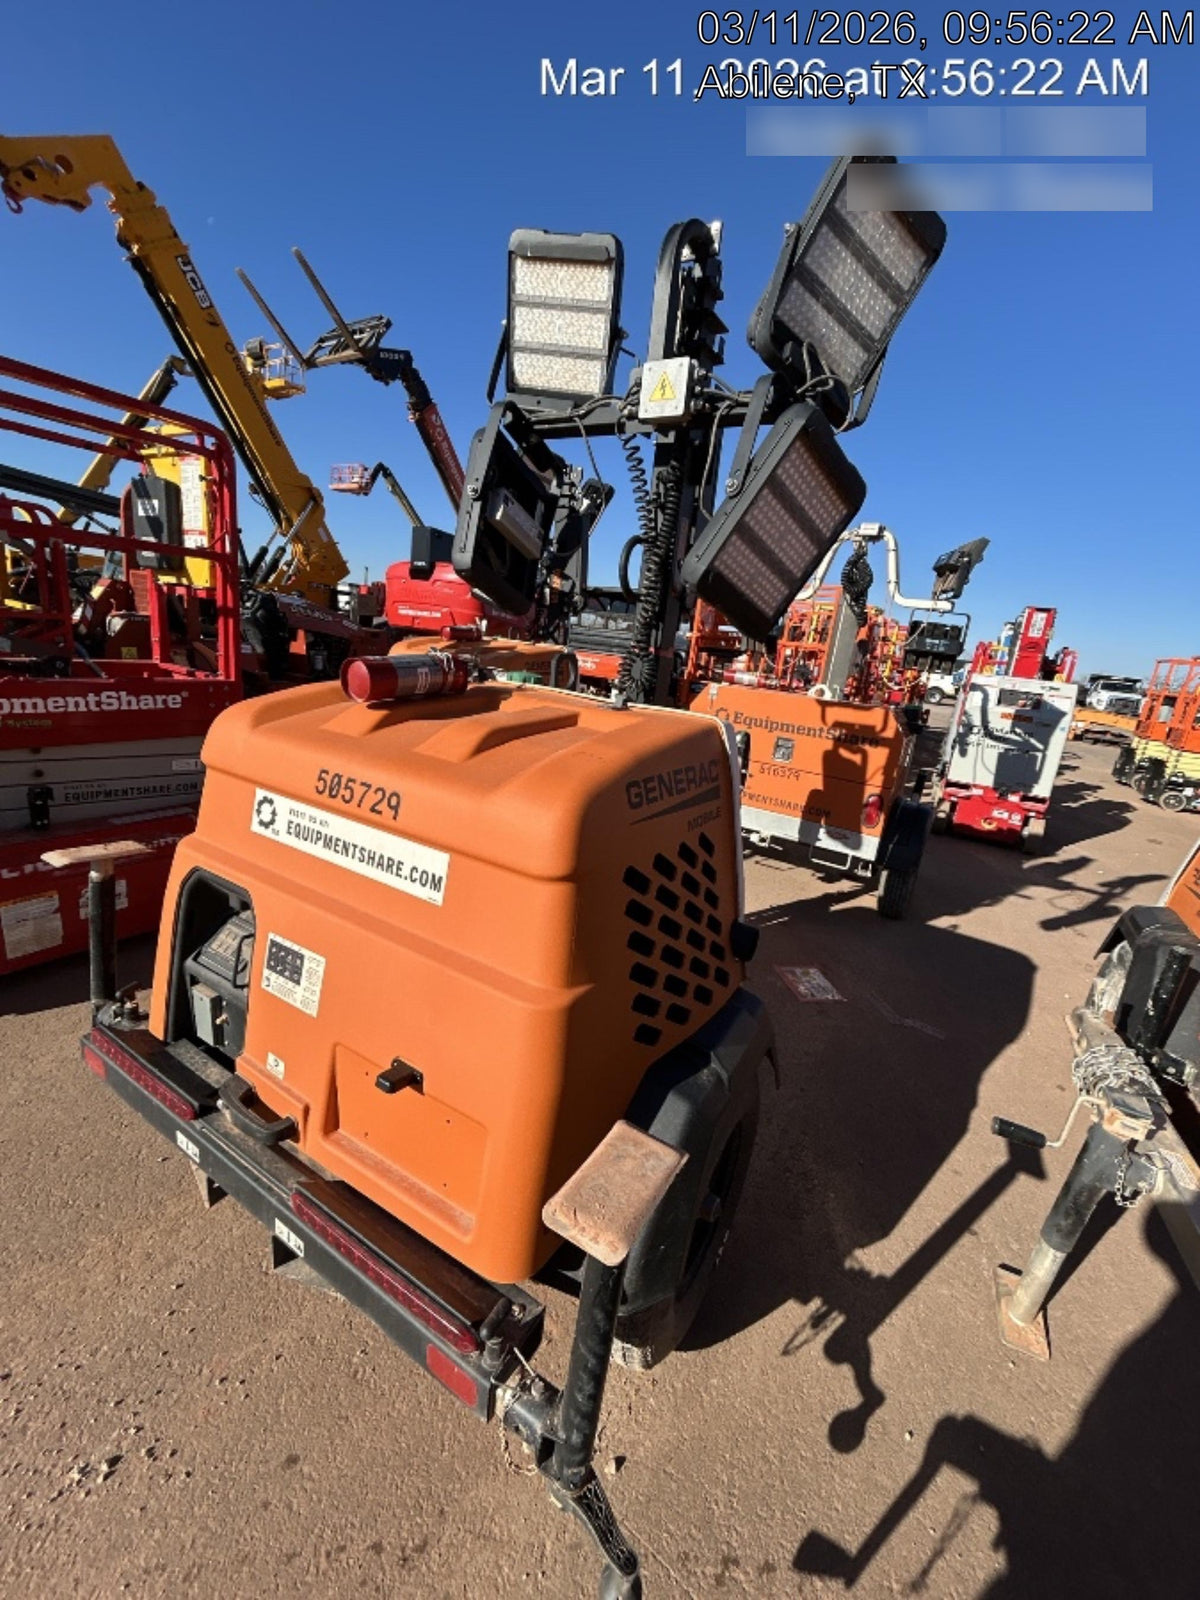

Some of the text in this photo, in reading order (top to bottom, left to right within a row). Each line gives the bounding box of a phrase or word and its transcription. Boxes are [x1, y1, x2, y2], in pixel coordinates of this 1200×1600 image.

[176, 255, 213, 309] JCB
[732, 710, 881, 747] EquipmentShare
[64, 782, 199, 802] EQUIPMENTSHARE.COM
[314, 768, 402, 821] 505729
[625, 760, 720, 810] GENERAC
[686, 806, 722, 833] MOBILE
[285, 819, 444, 893] EQUIPMENTSHARE.COM
